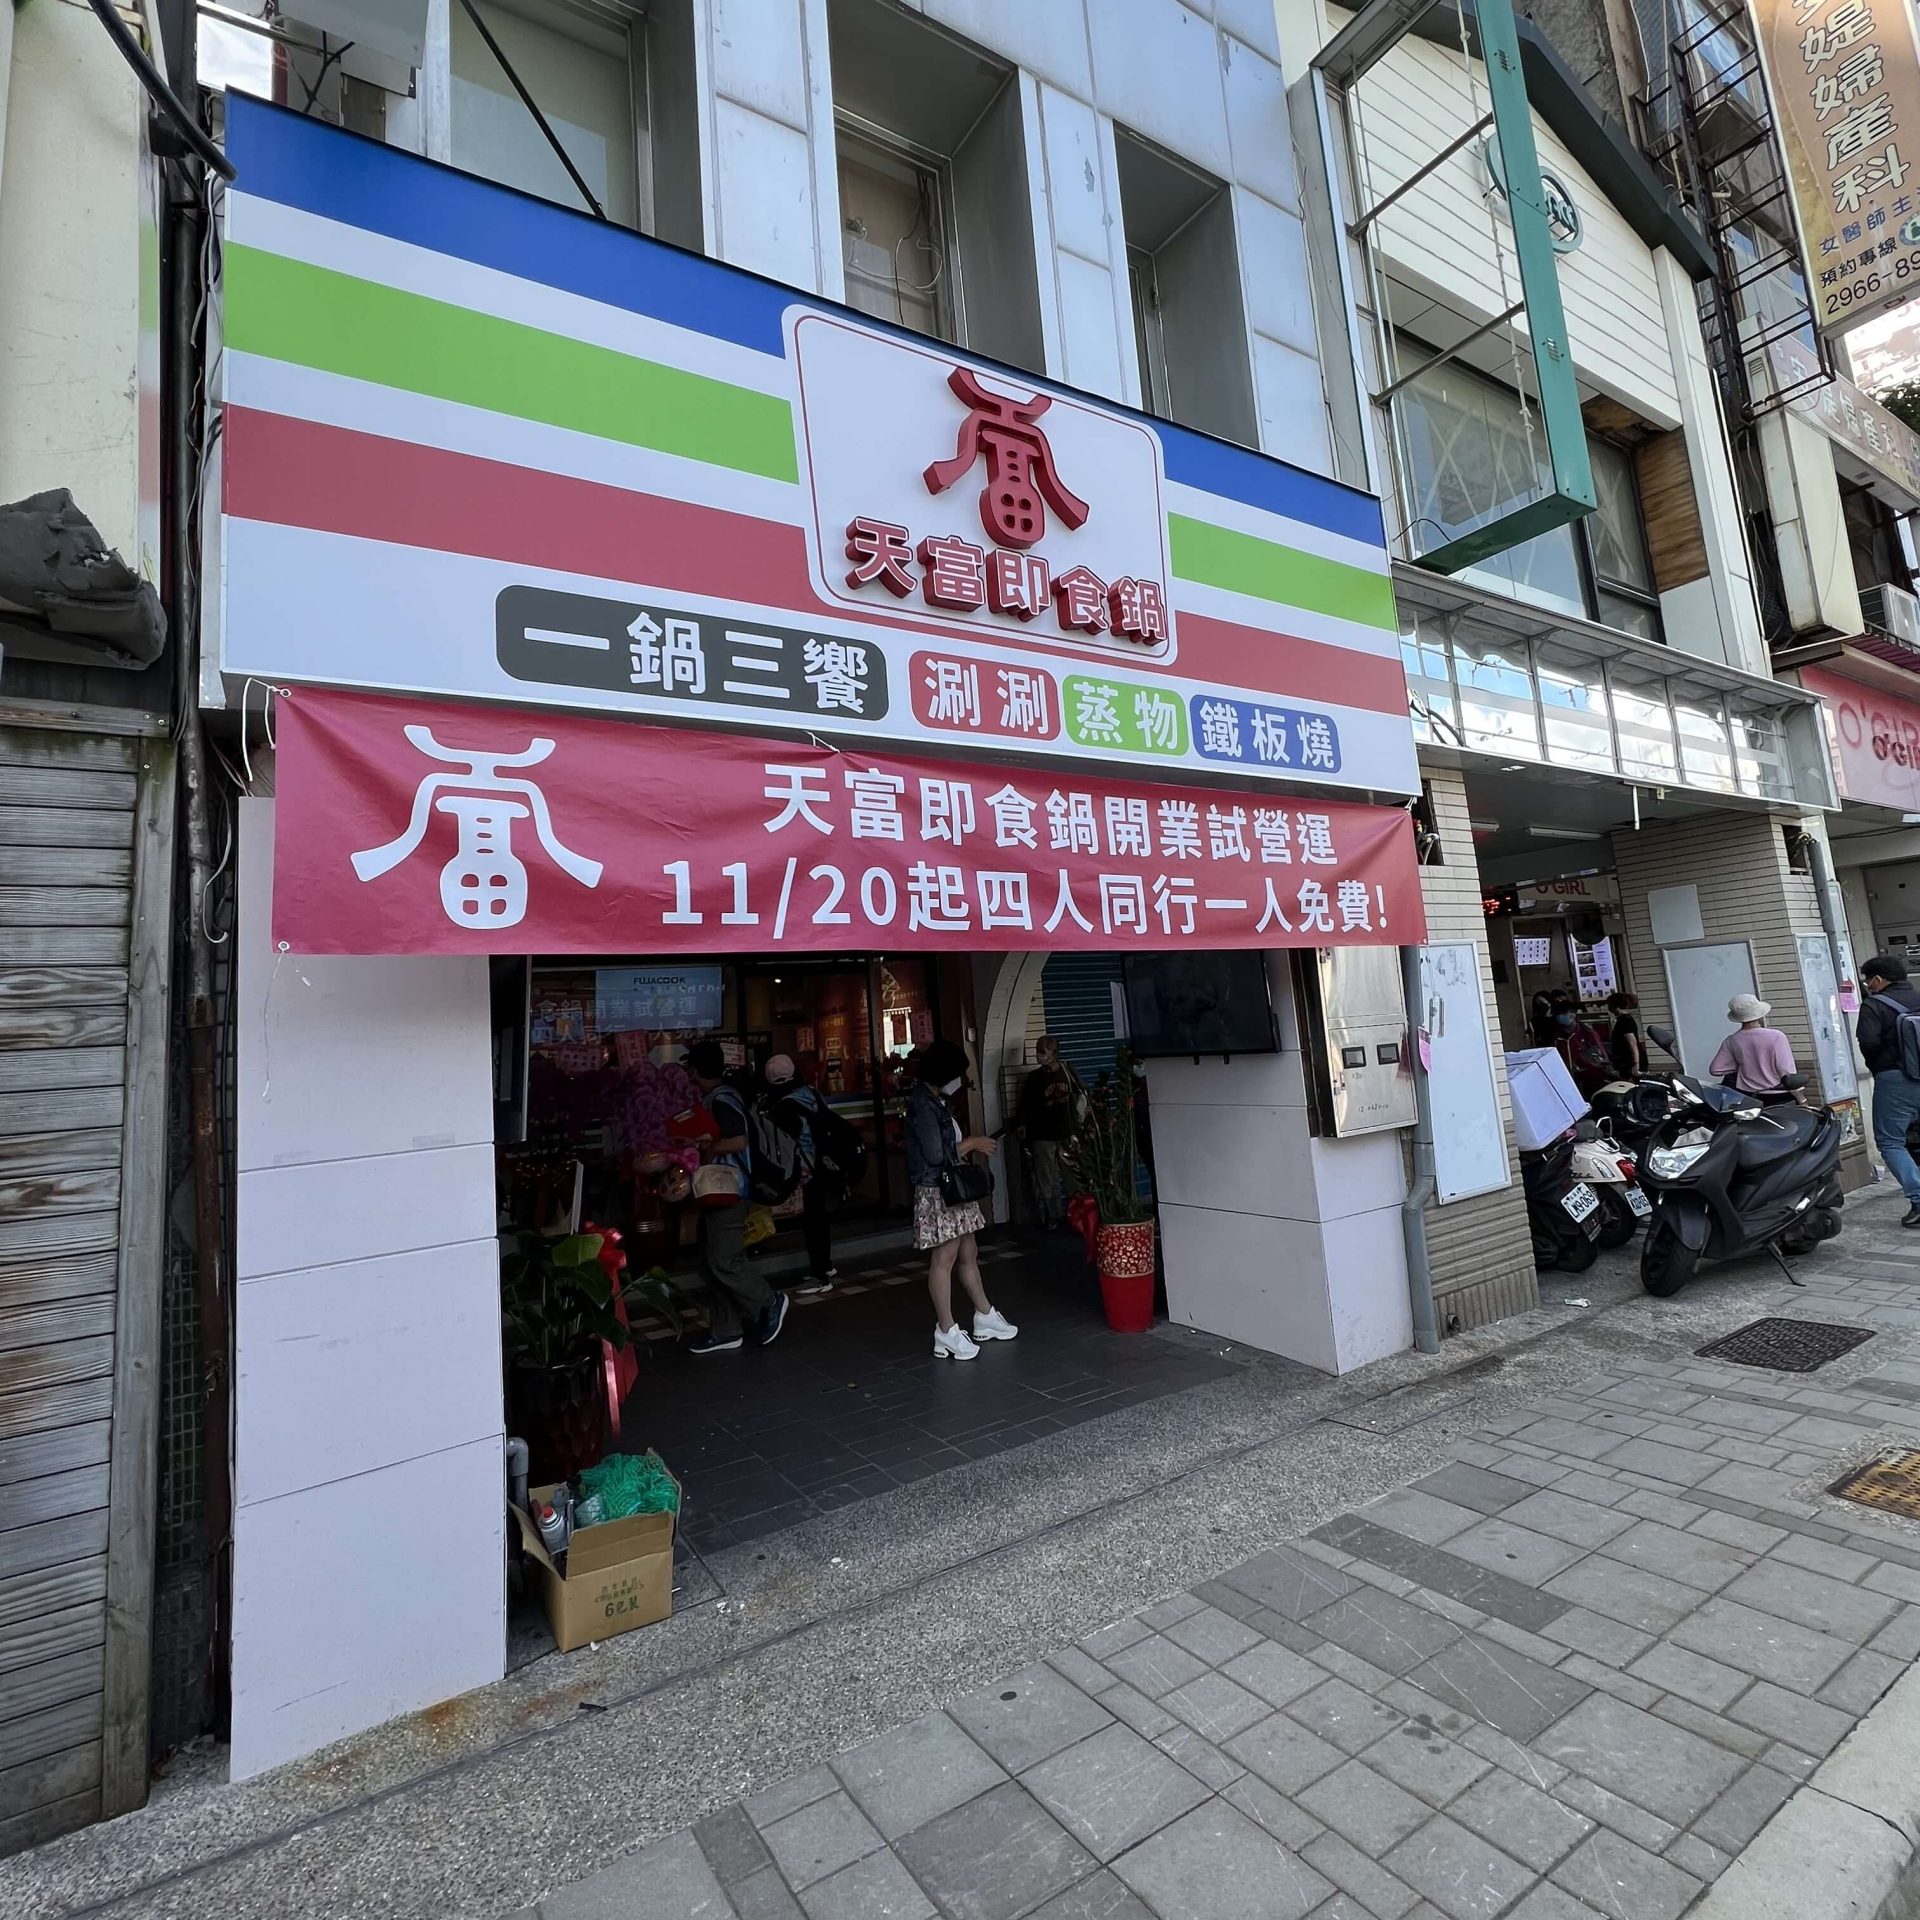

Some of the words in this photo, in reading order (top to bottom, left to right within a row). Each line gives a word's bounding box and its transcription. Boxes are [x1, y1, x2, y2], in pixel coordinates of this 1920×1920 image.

[1819, 188, 1920, 257] 女醫師主
[1819, 237, 1898, 289] 預約專線
[845, 516, 1167, 646] 天富即食鍋
[524, 611, 869, 713] 一鍋三饗
[924, 657, 1050, 735] 涮涮
[1074, 682, 1180, 750] 蒸物
[1200, 700, 1336, 769] 鐵板燒
[763, 763, 1338, 866] 天富即食鍋開業試營運
[633, 976, 686, 985] FUJACOOK
